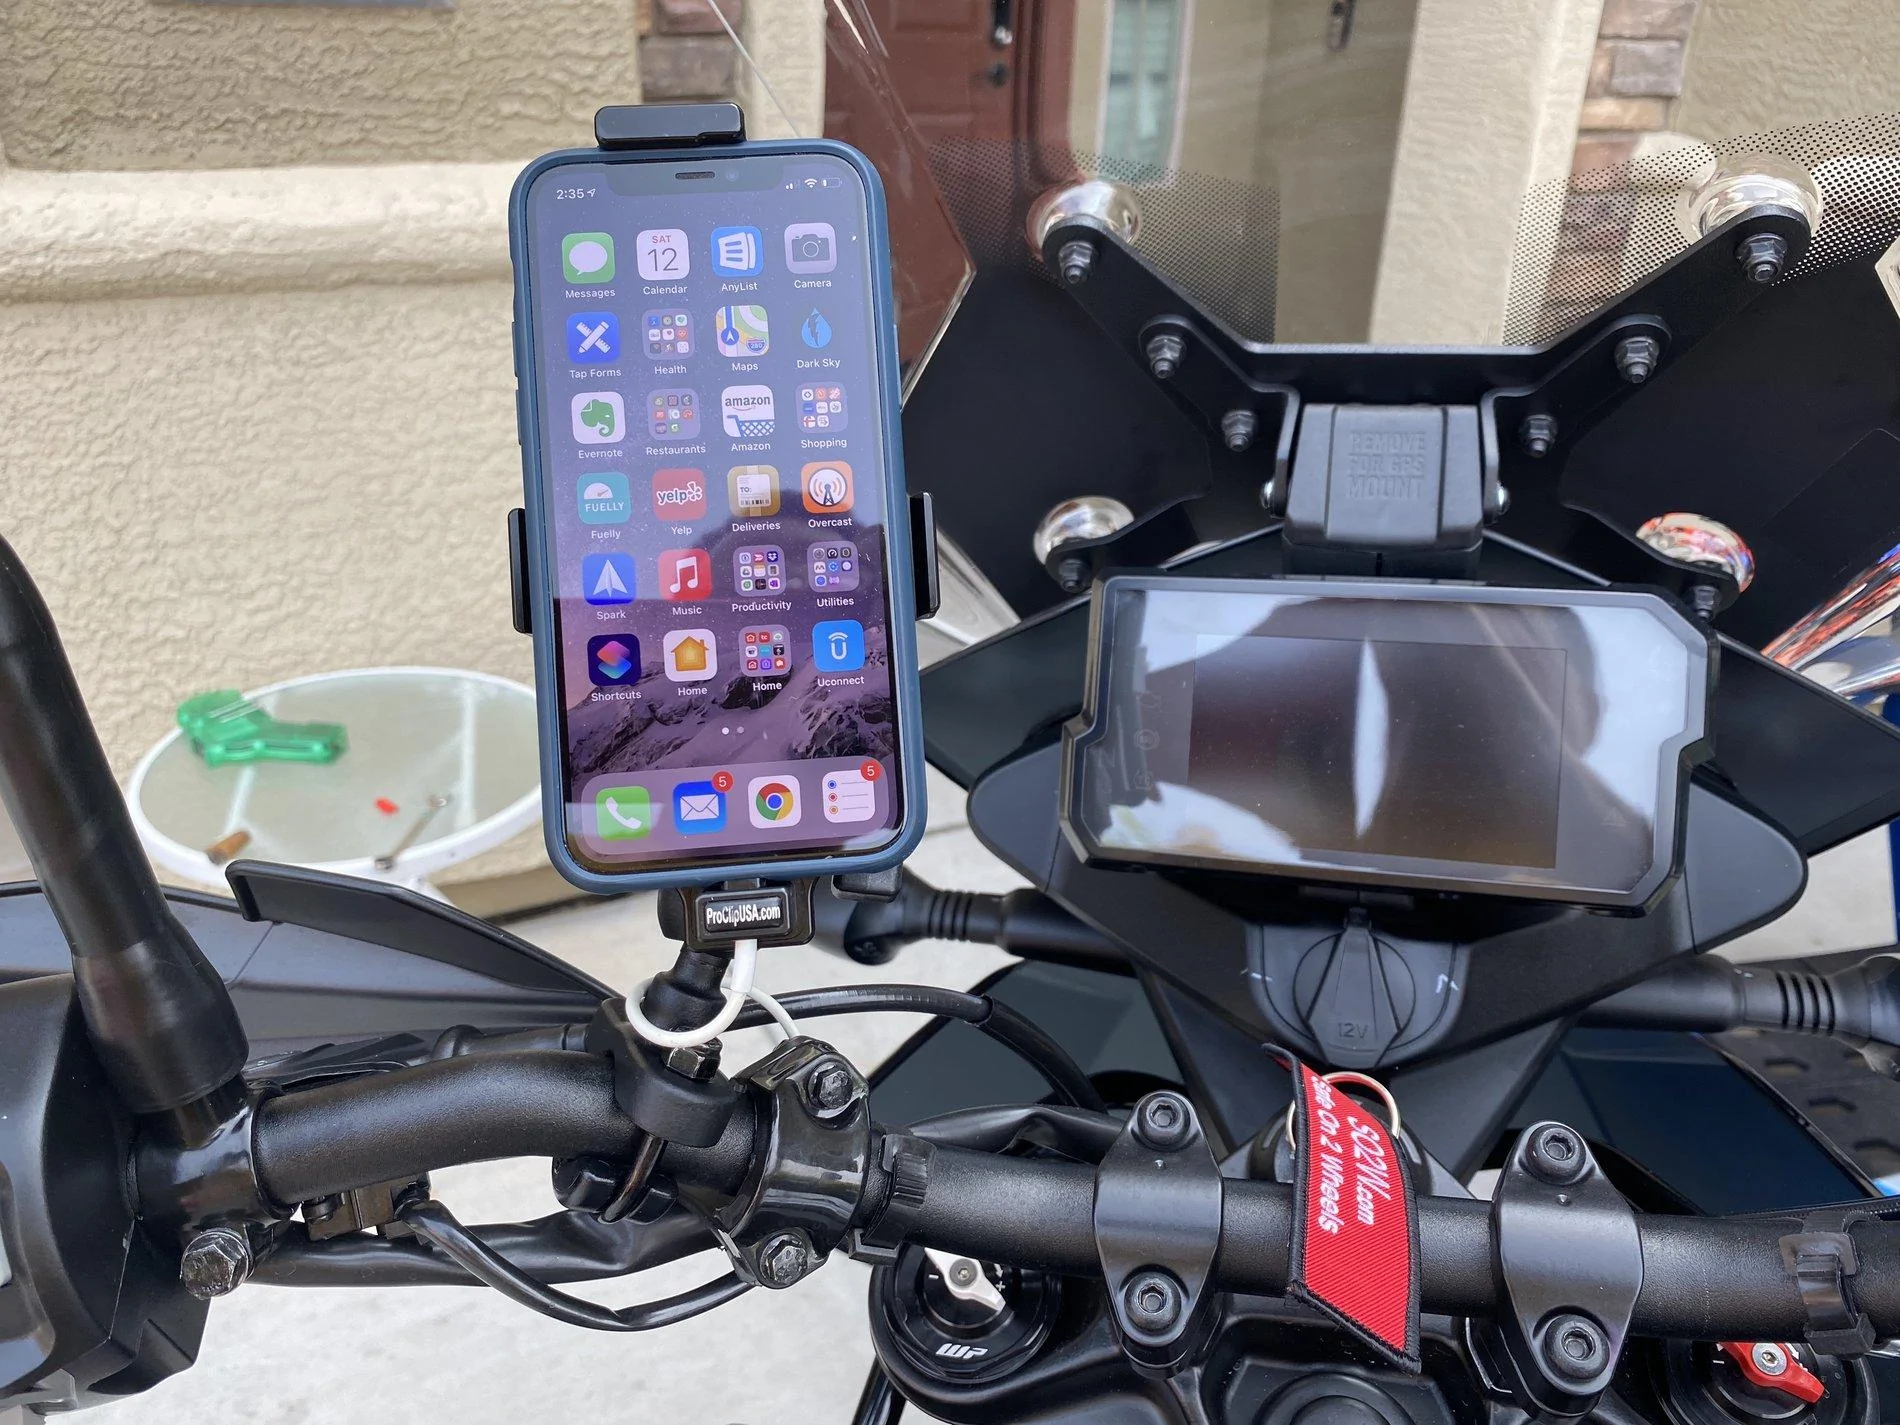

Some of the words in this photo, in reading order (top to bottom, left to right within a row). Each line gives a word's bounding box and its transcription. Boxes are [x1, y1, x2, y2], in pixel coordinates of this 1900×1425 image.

[556, 188, 585, 200] 2:35
[651, 235, 672, 244] SAT
[647, 247, 679, 272] 12
[721, 281, 758, 292] AnyList
[794, 278, 832, 289] Camera
[565, 288, 616, 299] Messages
[642, 285, 688, 295] Calendar
[732, 362, 759, 373] Maps
[796, 358, 820, 369] Dark
[821, 357, 841, 369] Sky
[570, 369, 588, 380] Tap
[590, 367, 622, 378] Forms
[654, 364, 687, 375] Health
[725, 395, 771, 407] amazon
[731, 441, 771, 452] Amazon
[800, 437, 847, 450] Shopping
[1350, 431, 1427, 452] REMOVE
[578, 448, 623, 459] Evernote
[646, 444, 706, 456] Restaurants
[1348, 453, 1384, 473] FOR
[1390, 453, 1425, 474] GPS
[1347, 474, 1425, 499] MOUNT
[657, 490, 687, 504] yelp
[585, 501, 624, 513] FUELLY
[732, 520, 781, 532] Deliveries
[808, 517, 852, 529] Overcast
[591, 528, 621, 540] Fuelly
[670, 525, 692, 536] Yelp
[731, 600, 792, 613] Productivity
[816, 596, 854, 607] Utilities
[596, 609, 626, 621] Spark
[672, 605, 702, 616] Music
[752, 680, 782, 691] Home
[817, 675, 865, 687] Uconnect
[591, 689, 642, 702] Shortcuts
[677, 685, 708, 696] Home
[866, 765, 875, 777] 5
[718, 776, 727, 788] 5
[706, 904, 781, 926] ProClipUSA.com
[1337, 1022, 1369, 1039] 12V
[1317, 1109, 1341, 1136] On
[1320, 1135, 1343, 1154] 2
[1317, 1153, 1346, 1235] Wheels
[935, 1342, 989, 1360] WP
